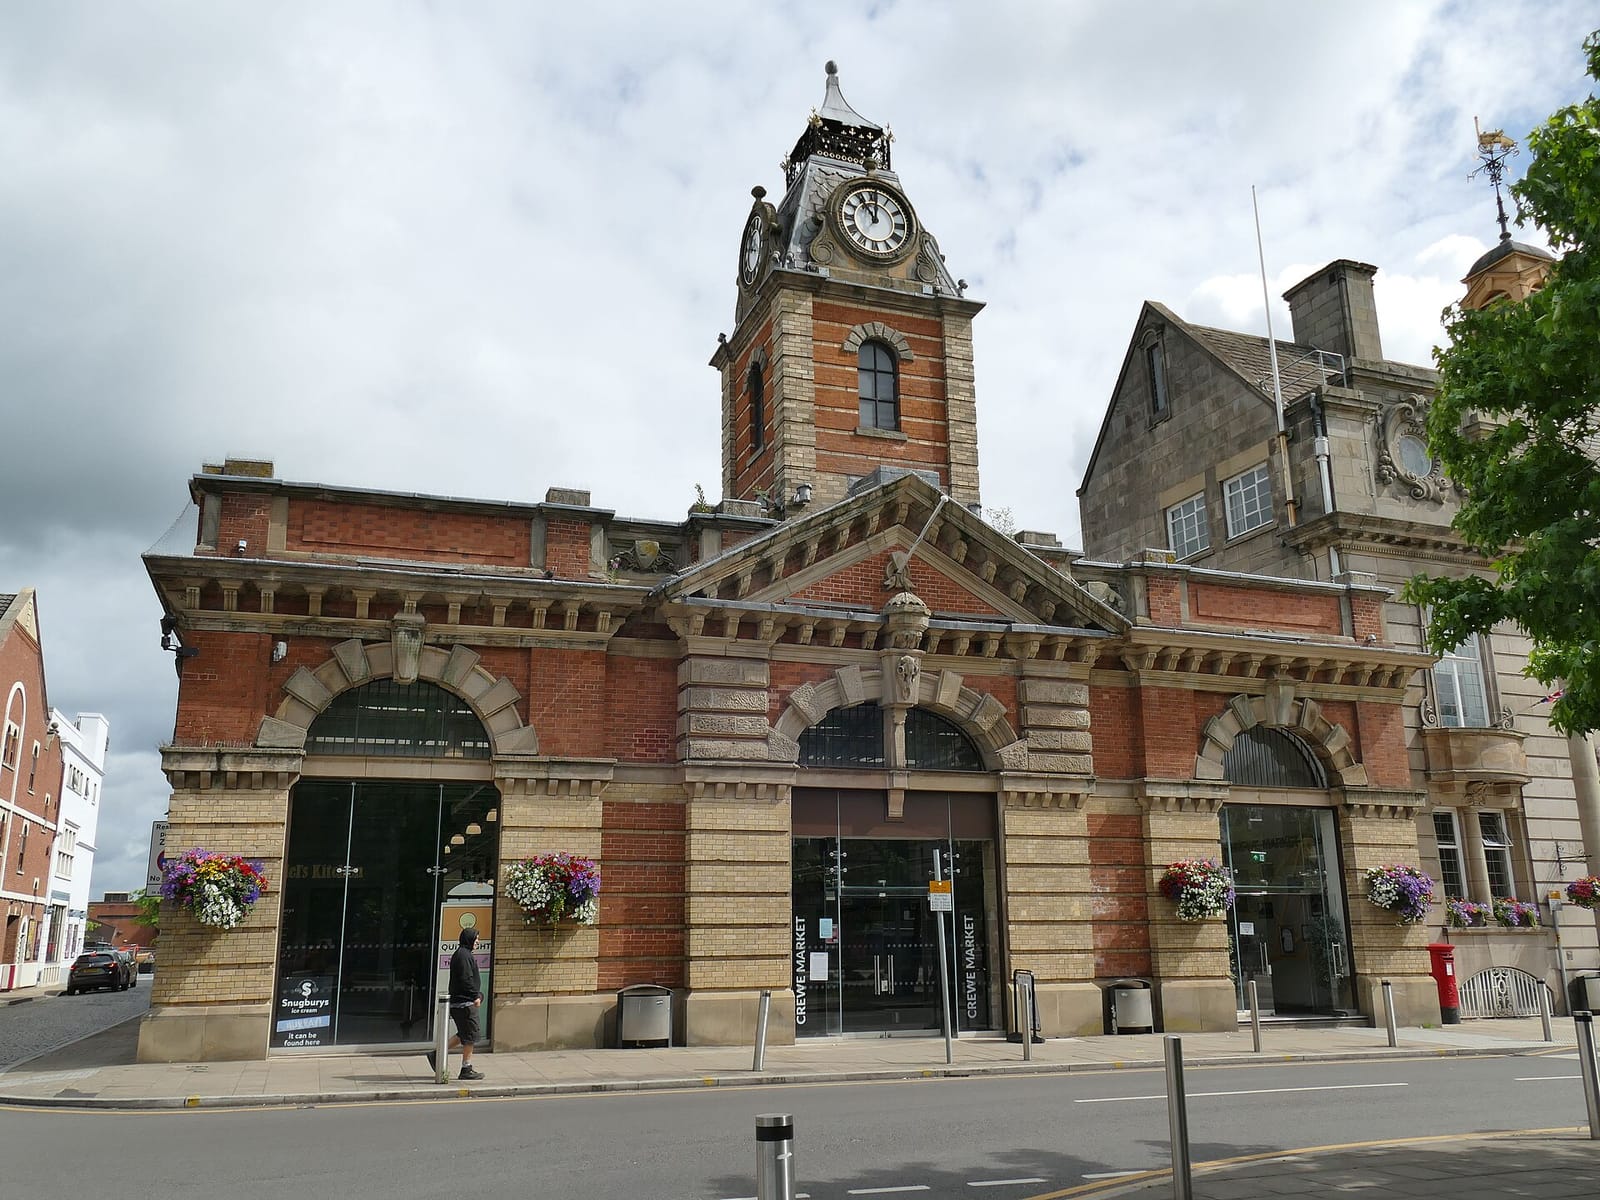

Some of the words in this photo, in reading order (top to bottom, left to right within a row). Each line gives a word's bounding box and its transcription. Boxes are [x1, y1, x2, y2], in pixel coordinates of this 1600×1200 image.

[795, 915, 806, 973] MARKET
[963, 914, 976, 969] MARKET
[281, 999, 329, 1008] Snugburys
[796, 975, 806, 1025] CREWE
[966, 971, 977, 1018] CREWE
[284, 1039, 304, 1047] found
